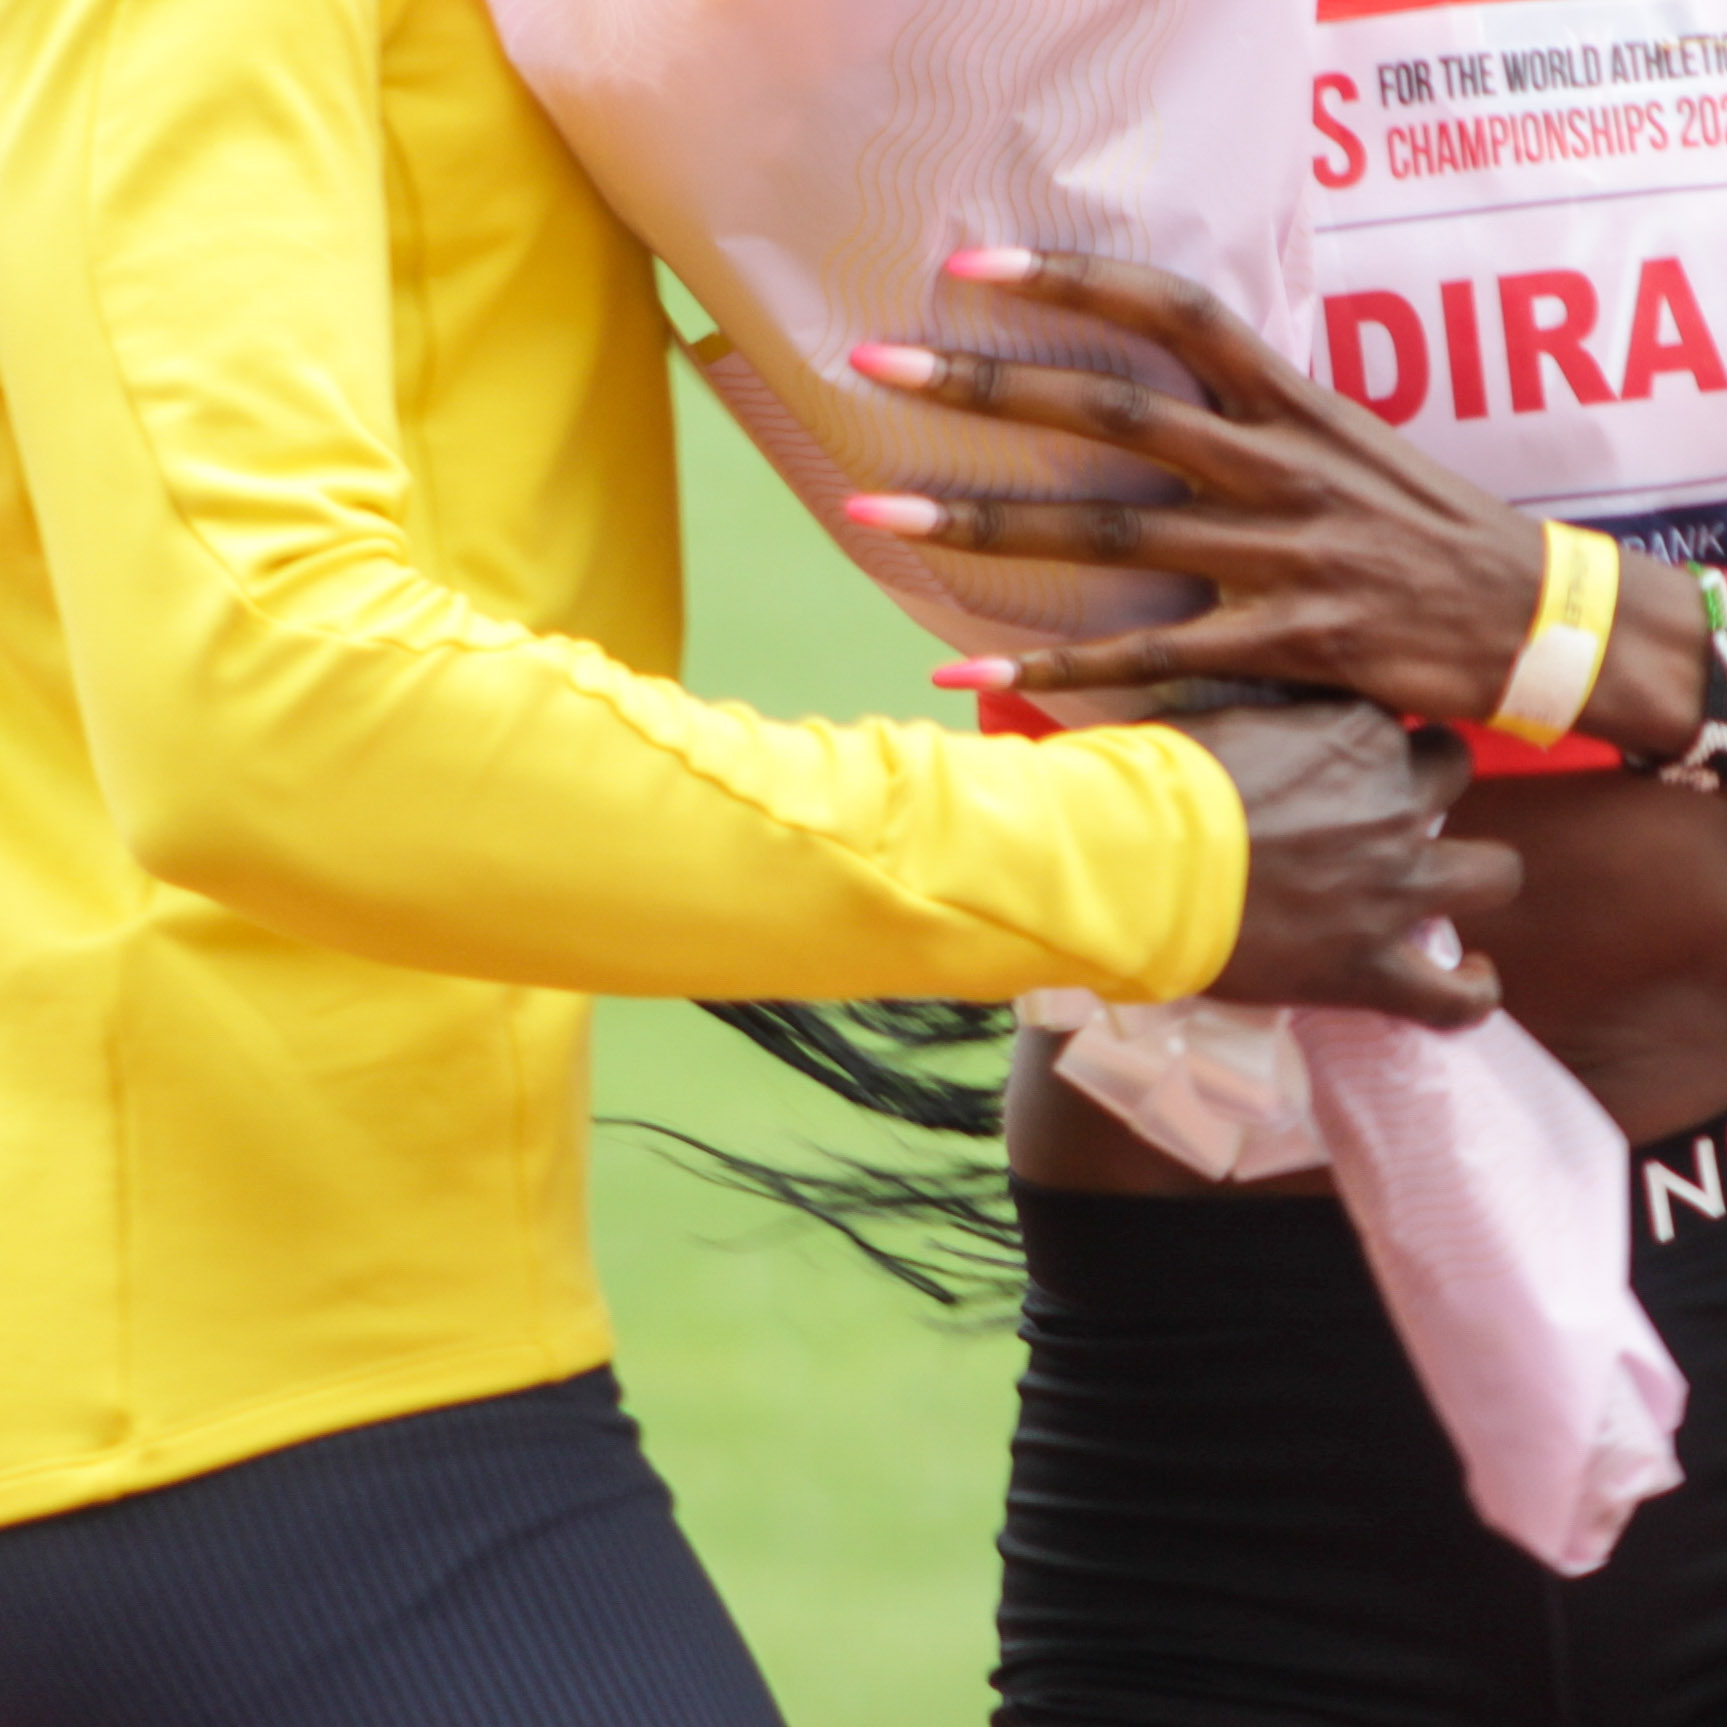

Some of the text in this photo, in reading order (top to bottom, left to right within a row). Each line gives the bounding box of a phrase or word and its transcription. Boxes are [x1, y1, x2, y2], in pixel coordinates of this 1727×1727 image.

[1377, 60, 1435, 108] FOR
[1438, 52, 1495, 101] THE
[1502, 44, 1603, 96] WORLD
[1312, 70, 1367, 190] S
[1386, 100, 1670, 181] CHAMPIONSHIPS
